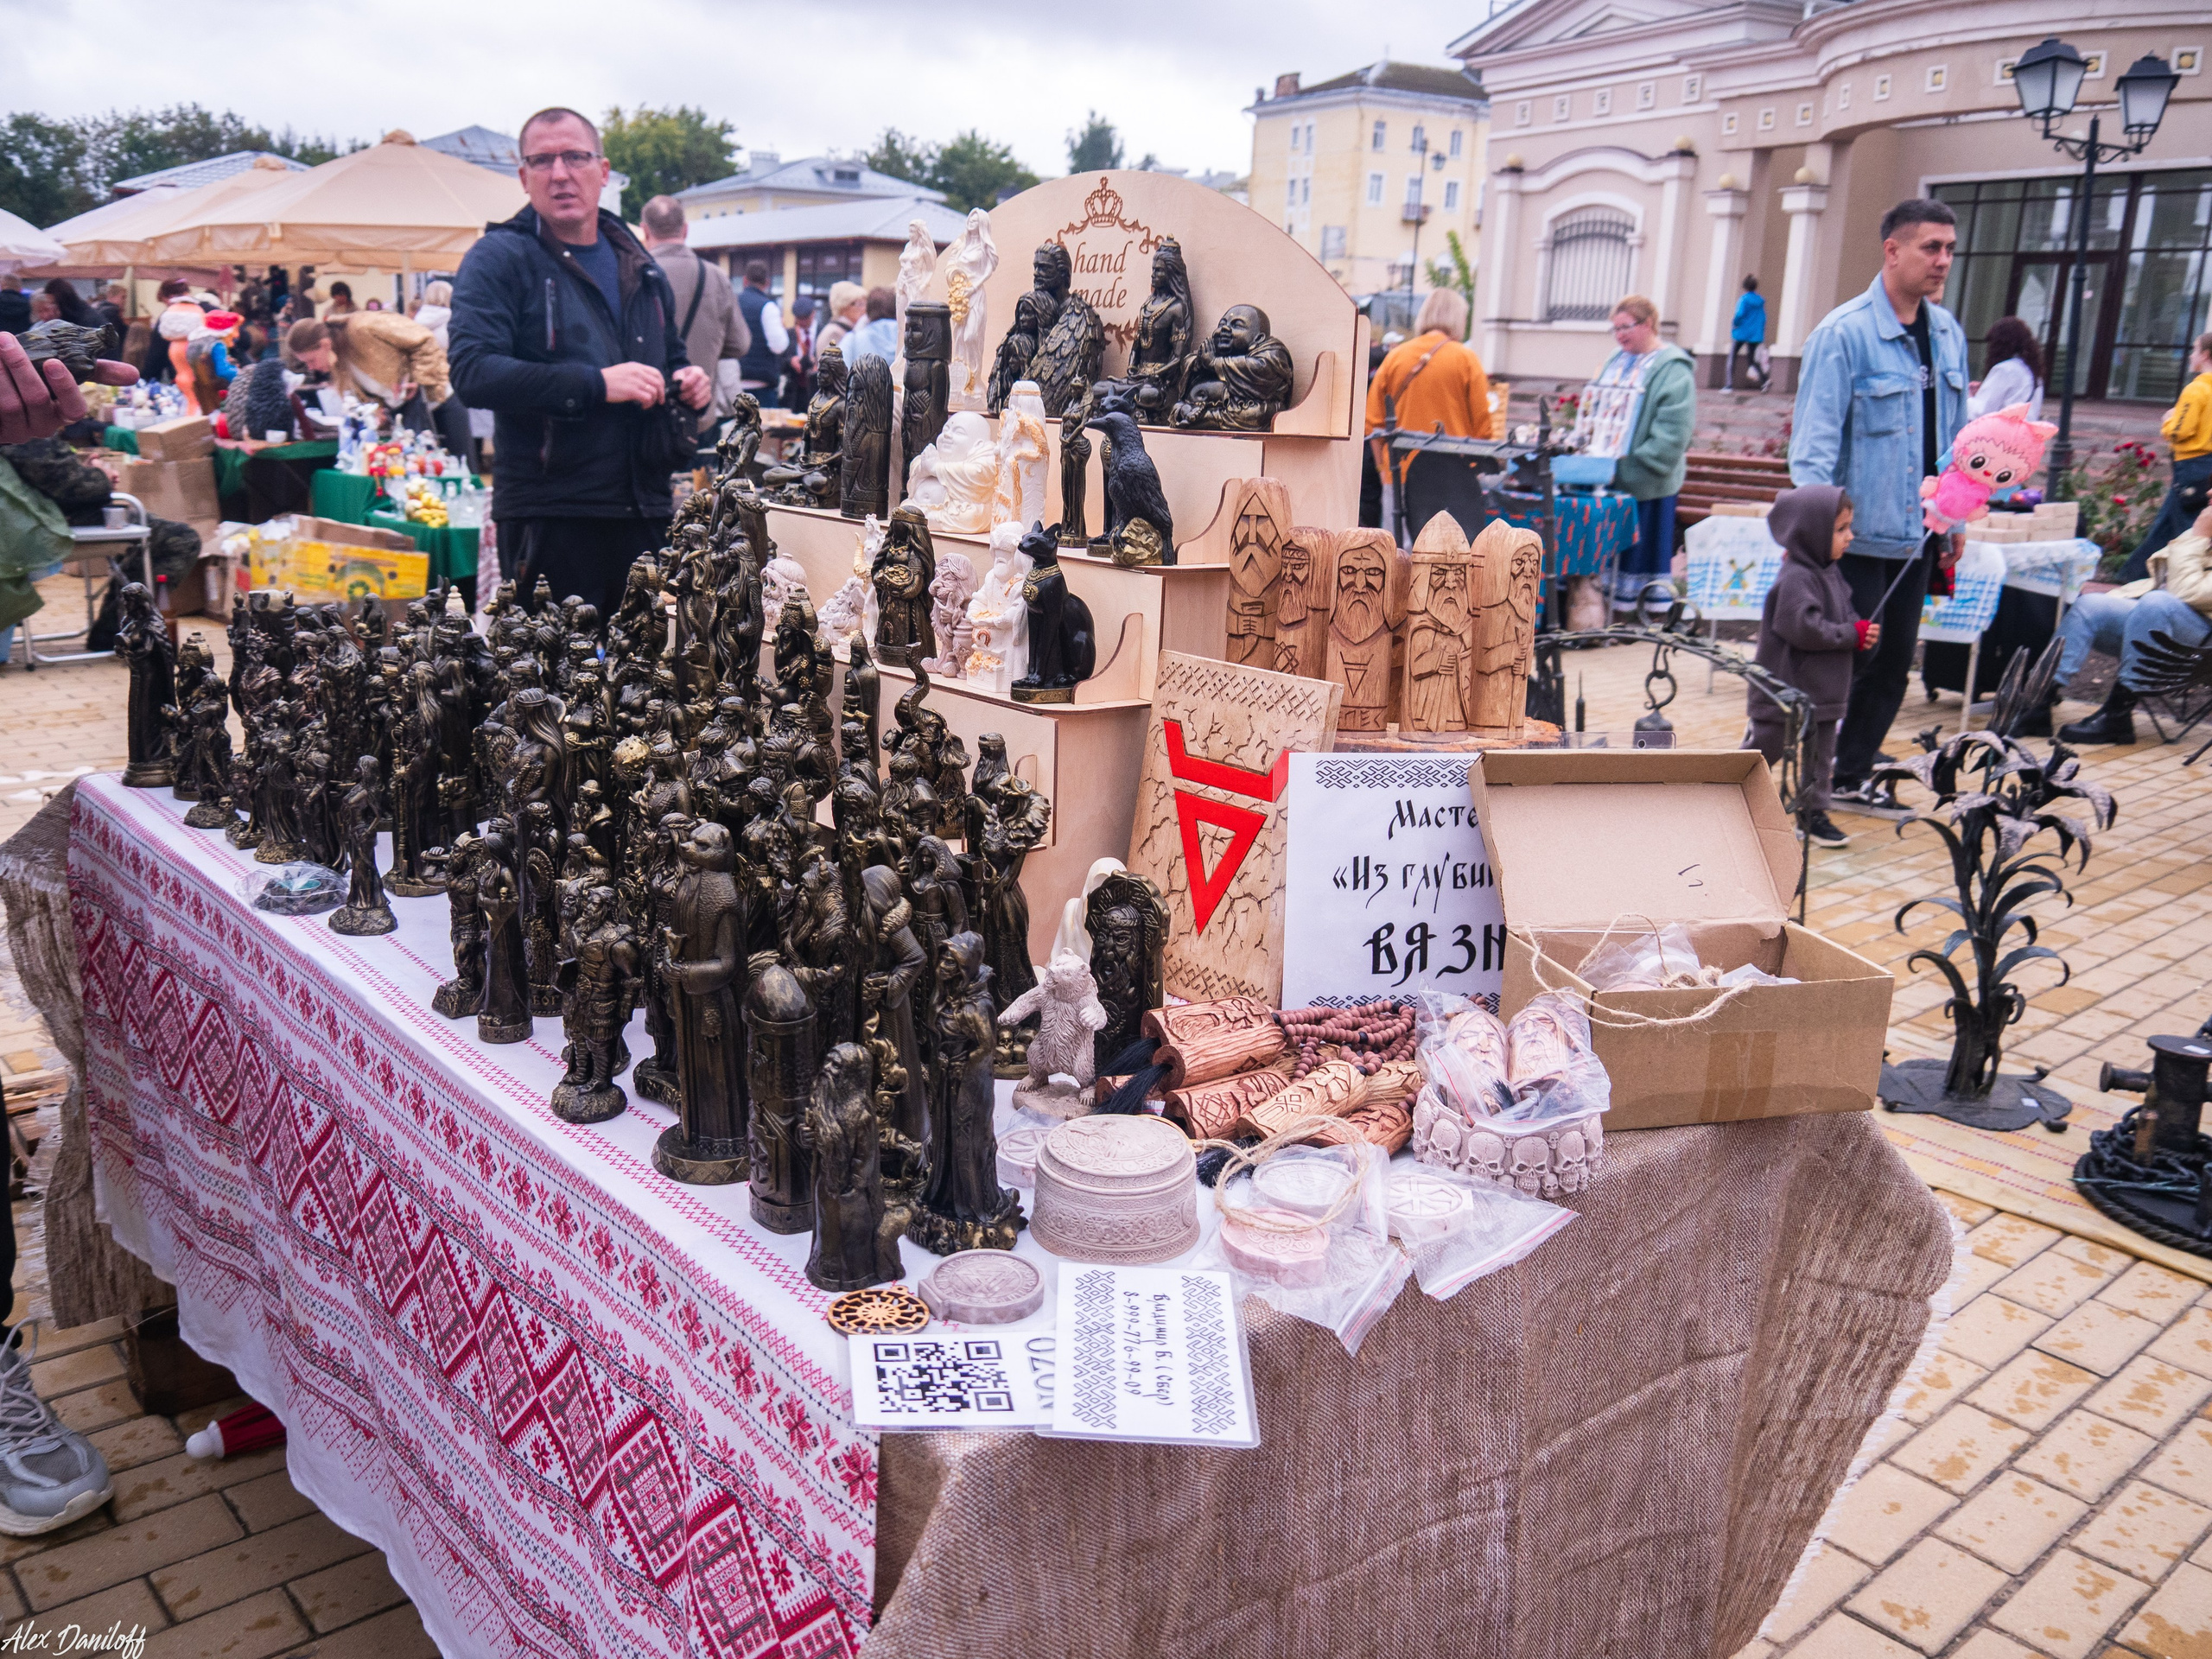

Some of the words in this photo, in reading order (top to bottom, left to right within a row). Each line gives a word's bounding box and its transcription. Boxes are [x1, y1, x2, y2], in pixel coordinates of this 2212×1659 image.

[1072, 240, 1134, 274] hand
[1388, 799, 1480, 841] Масте
[1332, 855, 1389, 910] «Из
[1402, 851, 1494, 914] глуби
